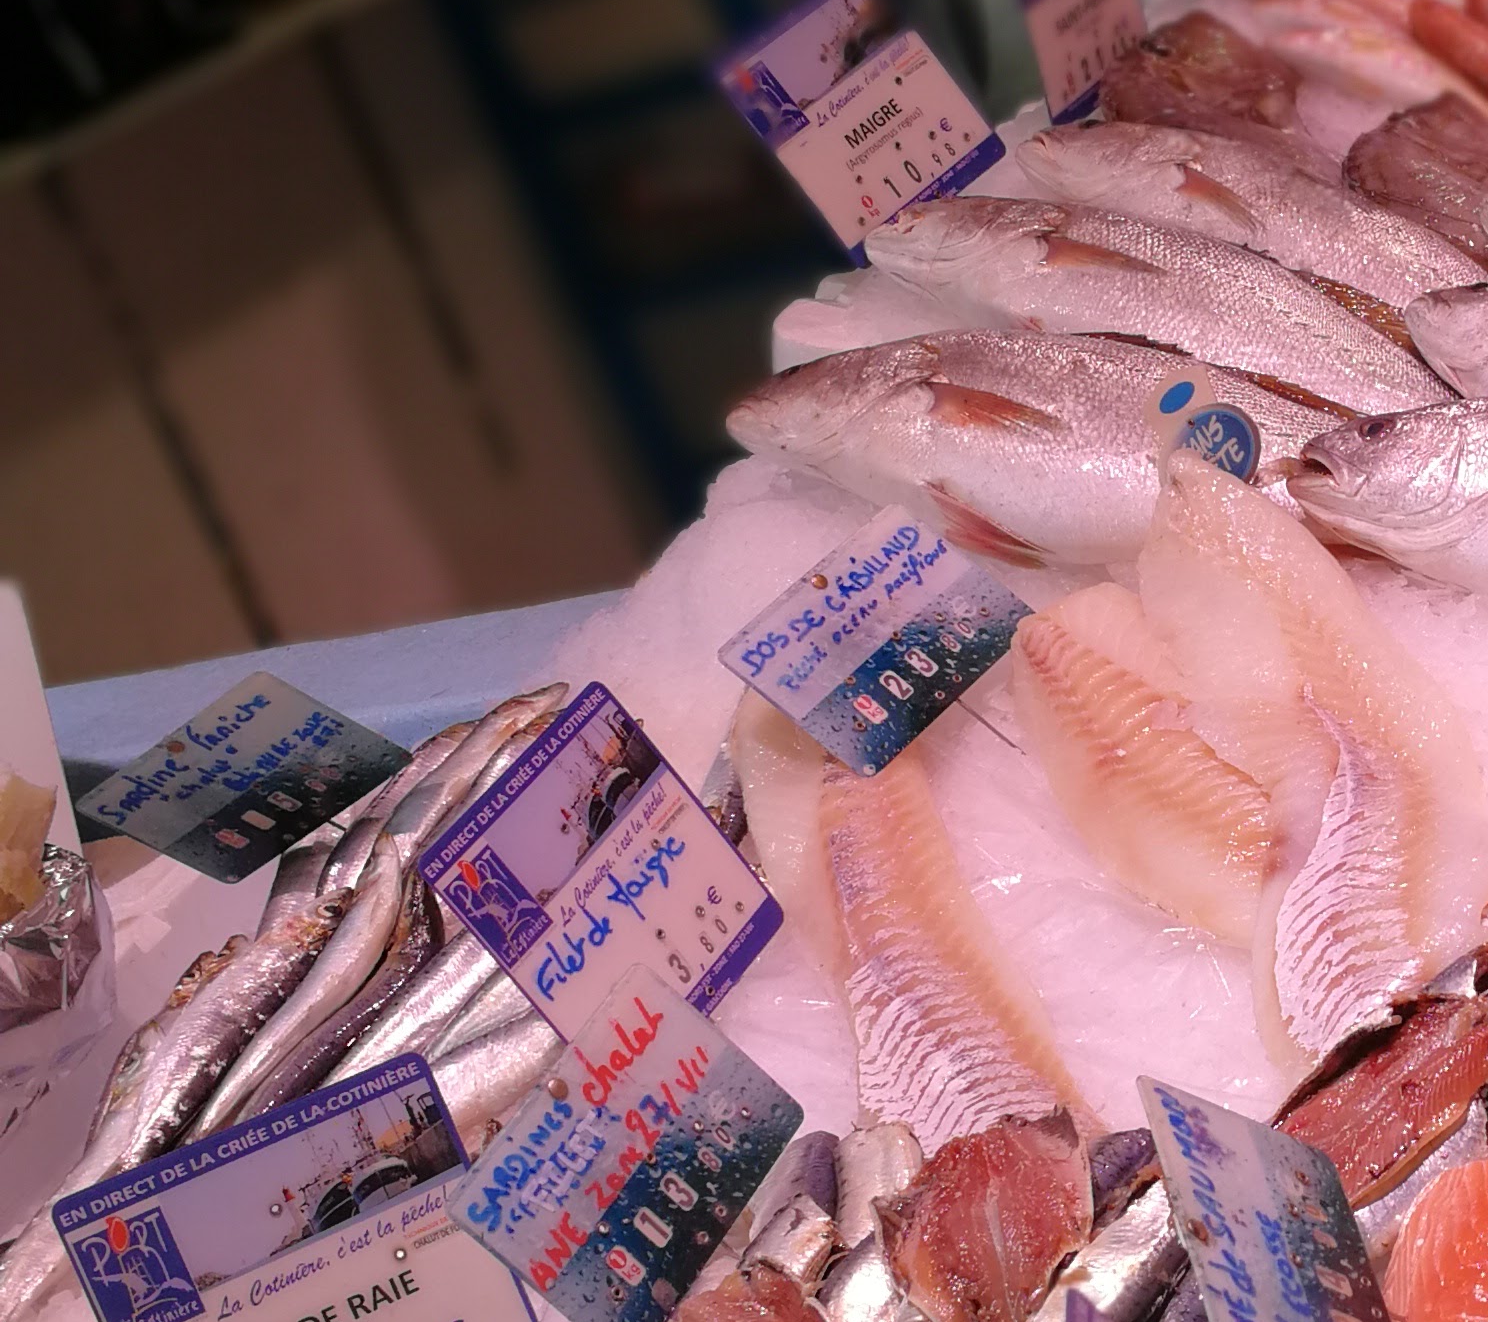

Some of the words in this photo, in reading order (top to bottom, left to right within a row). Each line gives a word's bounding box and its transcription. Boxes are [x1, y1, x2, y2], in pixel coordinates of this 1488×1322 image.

[843, 96, 903, 150] MAIGRE
[895, 107, 923, 136] regius)
[1183, 414, 1224, 453] ANS
[741, 631, 790, 677] DOS
[787, 609, 826, 643] DE
[424, 857, 445, 880] EN
[442, 822, 478, 863] DIRECT
[475, 806, 494, 828] DE
[491, 792, 509, 811] LA
[505, 762, 535, 798] CRIÉE
[532, 748, 549, 769] DE
[545, 734, 562, 753] LA
[557, 687, 607, 743] COTINIÈRE
[560, 905, 577, 928] La
[60, 1204, 85, 1228] EN
[90, 1177, 156, 1215] DIRECT
[160, 1162, 188, 1184] DE
[190, 1151, 216, 1172] LA
[217, 1128, 270, 1159] CRIÉE
[271, 1114, 298, 1135] DE
[300, 1103, 324, 1123] LA
[326, 1061, 421, 1112] COTINIÈRE
[216, 1295, 245, 1322] La
[337, 1230, 373, 1260] c'est
[376, 1216, 396, 1239] la
[529, 1212, 590, 1293] ANE
[347, 1269, 420, 1320] RAIE
